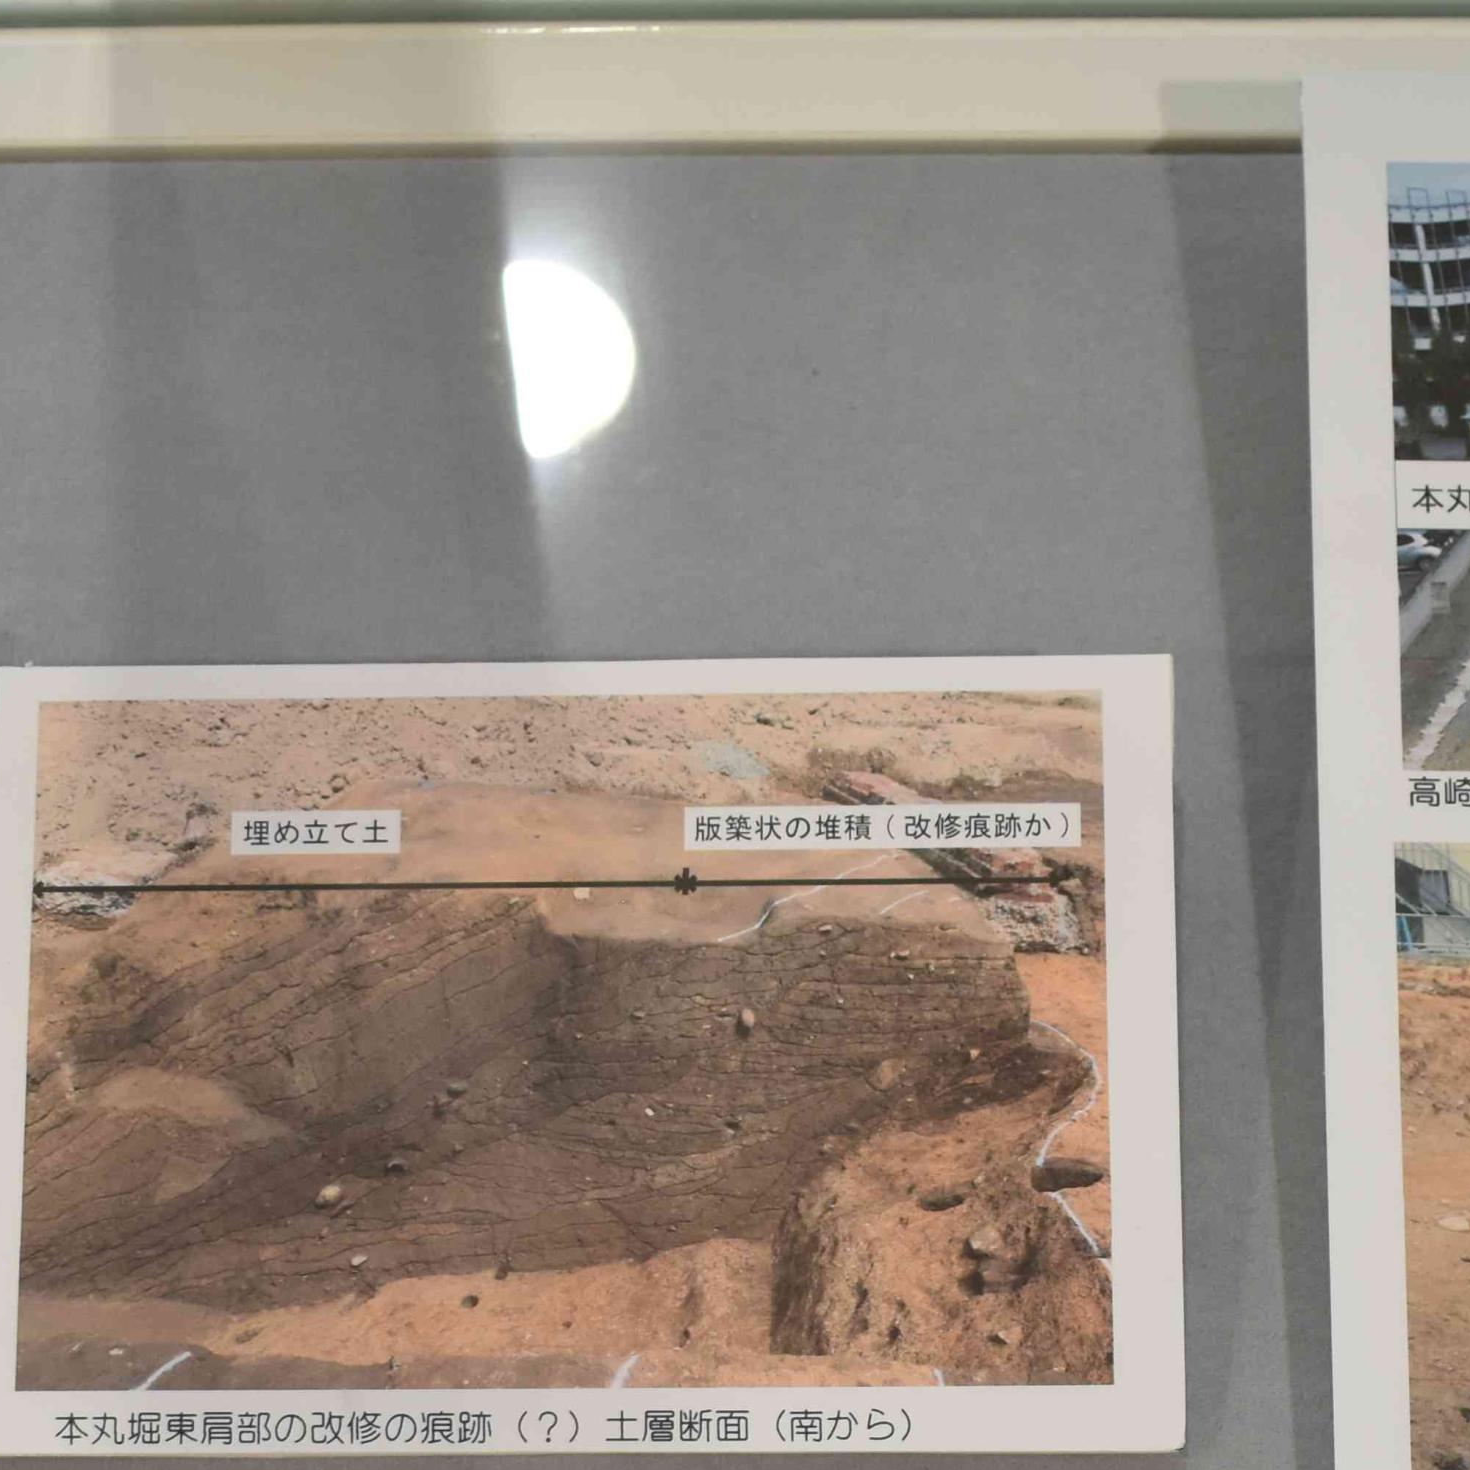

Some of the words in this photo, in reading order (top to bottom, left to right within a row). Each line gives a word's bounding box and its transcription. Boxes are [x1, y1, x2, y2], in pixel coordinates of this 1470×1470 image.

[243, 819, 389, 846] 埋め立て土
[695, 812, 1071, 840] 版築状の堆積（改修痕跡か）
